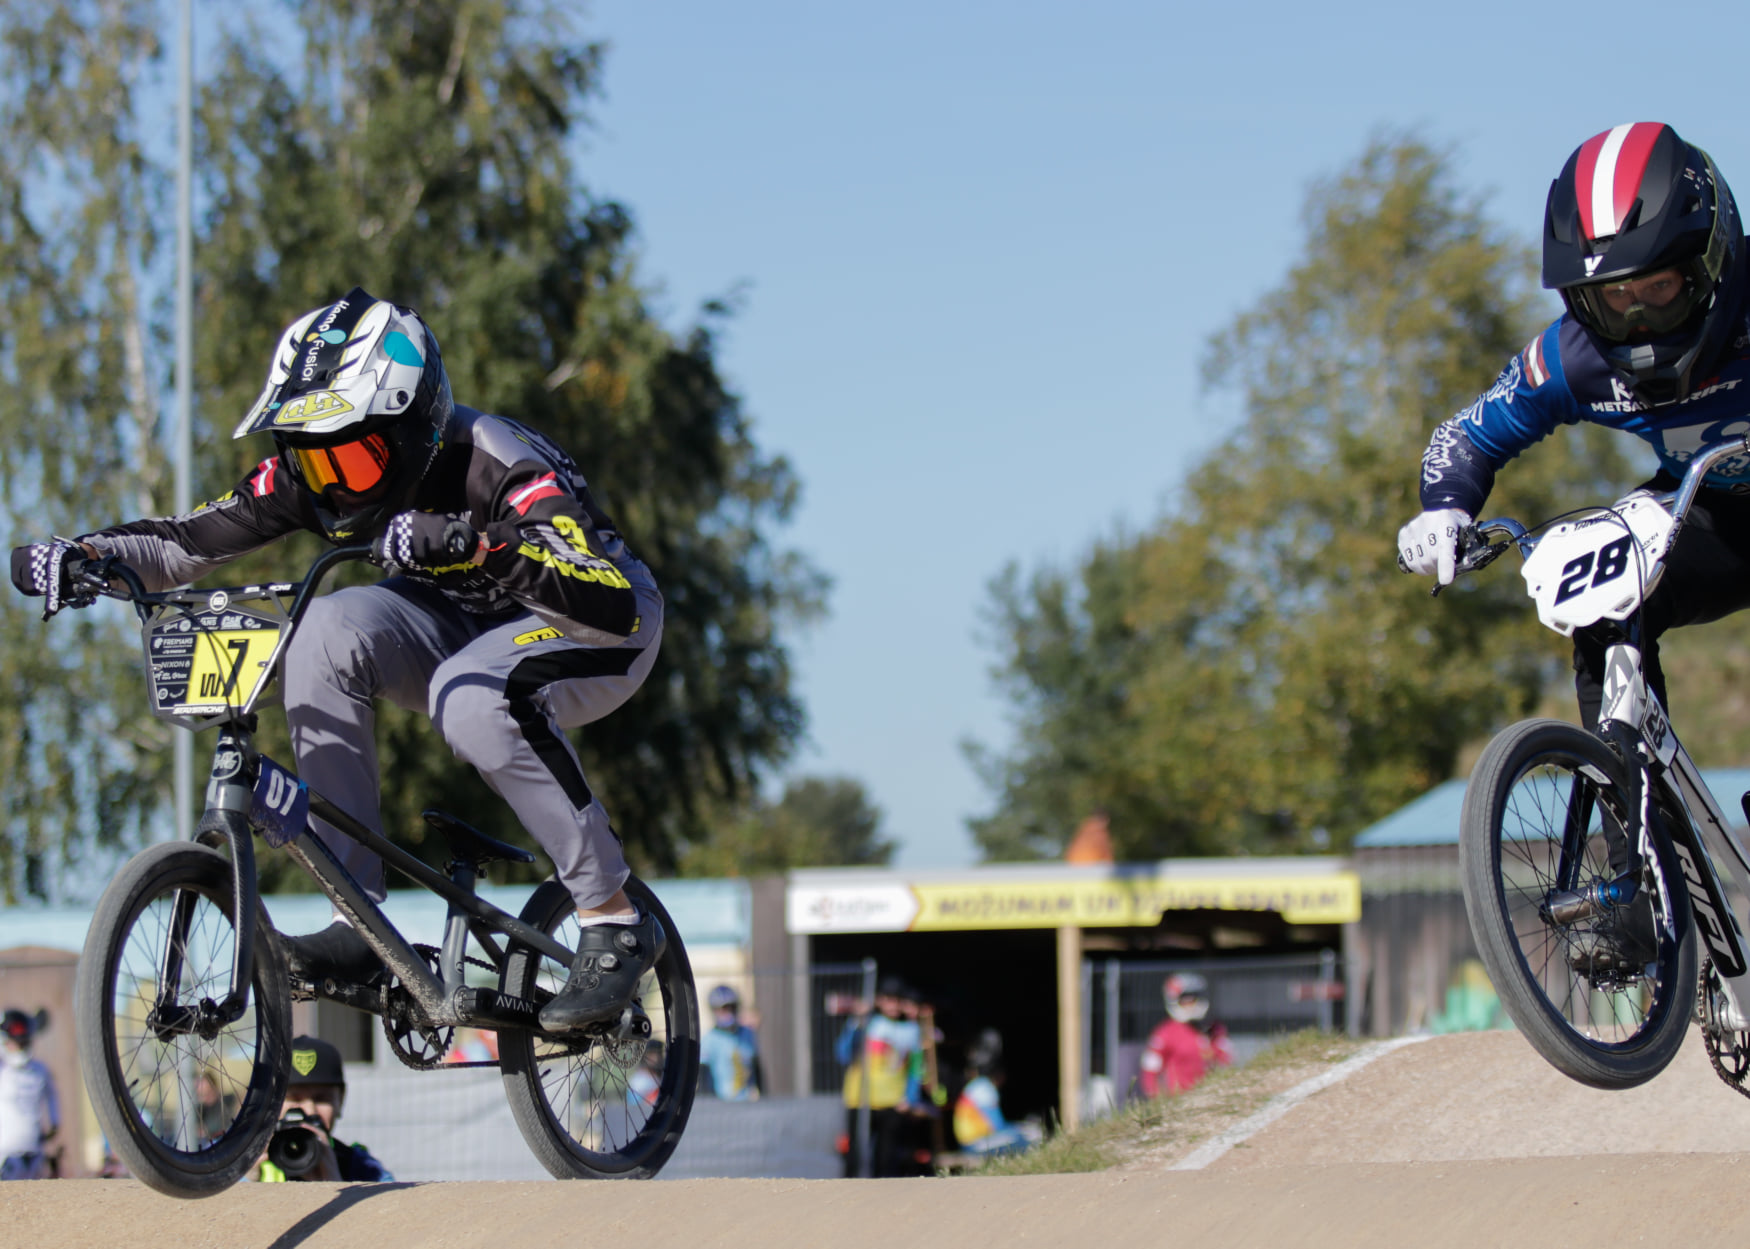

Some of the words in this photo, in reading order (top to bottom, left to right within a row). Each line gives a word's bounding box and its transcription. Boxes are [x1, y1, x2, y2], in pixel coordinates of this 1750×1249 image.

[1553, 534, 1632, 607] 28
[265, 768, 299, 816] 07
[1672, 839, 1740, 969] RIFT
[496, 995, 533, 1013] AVIAN
